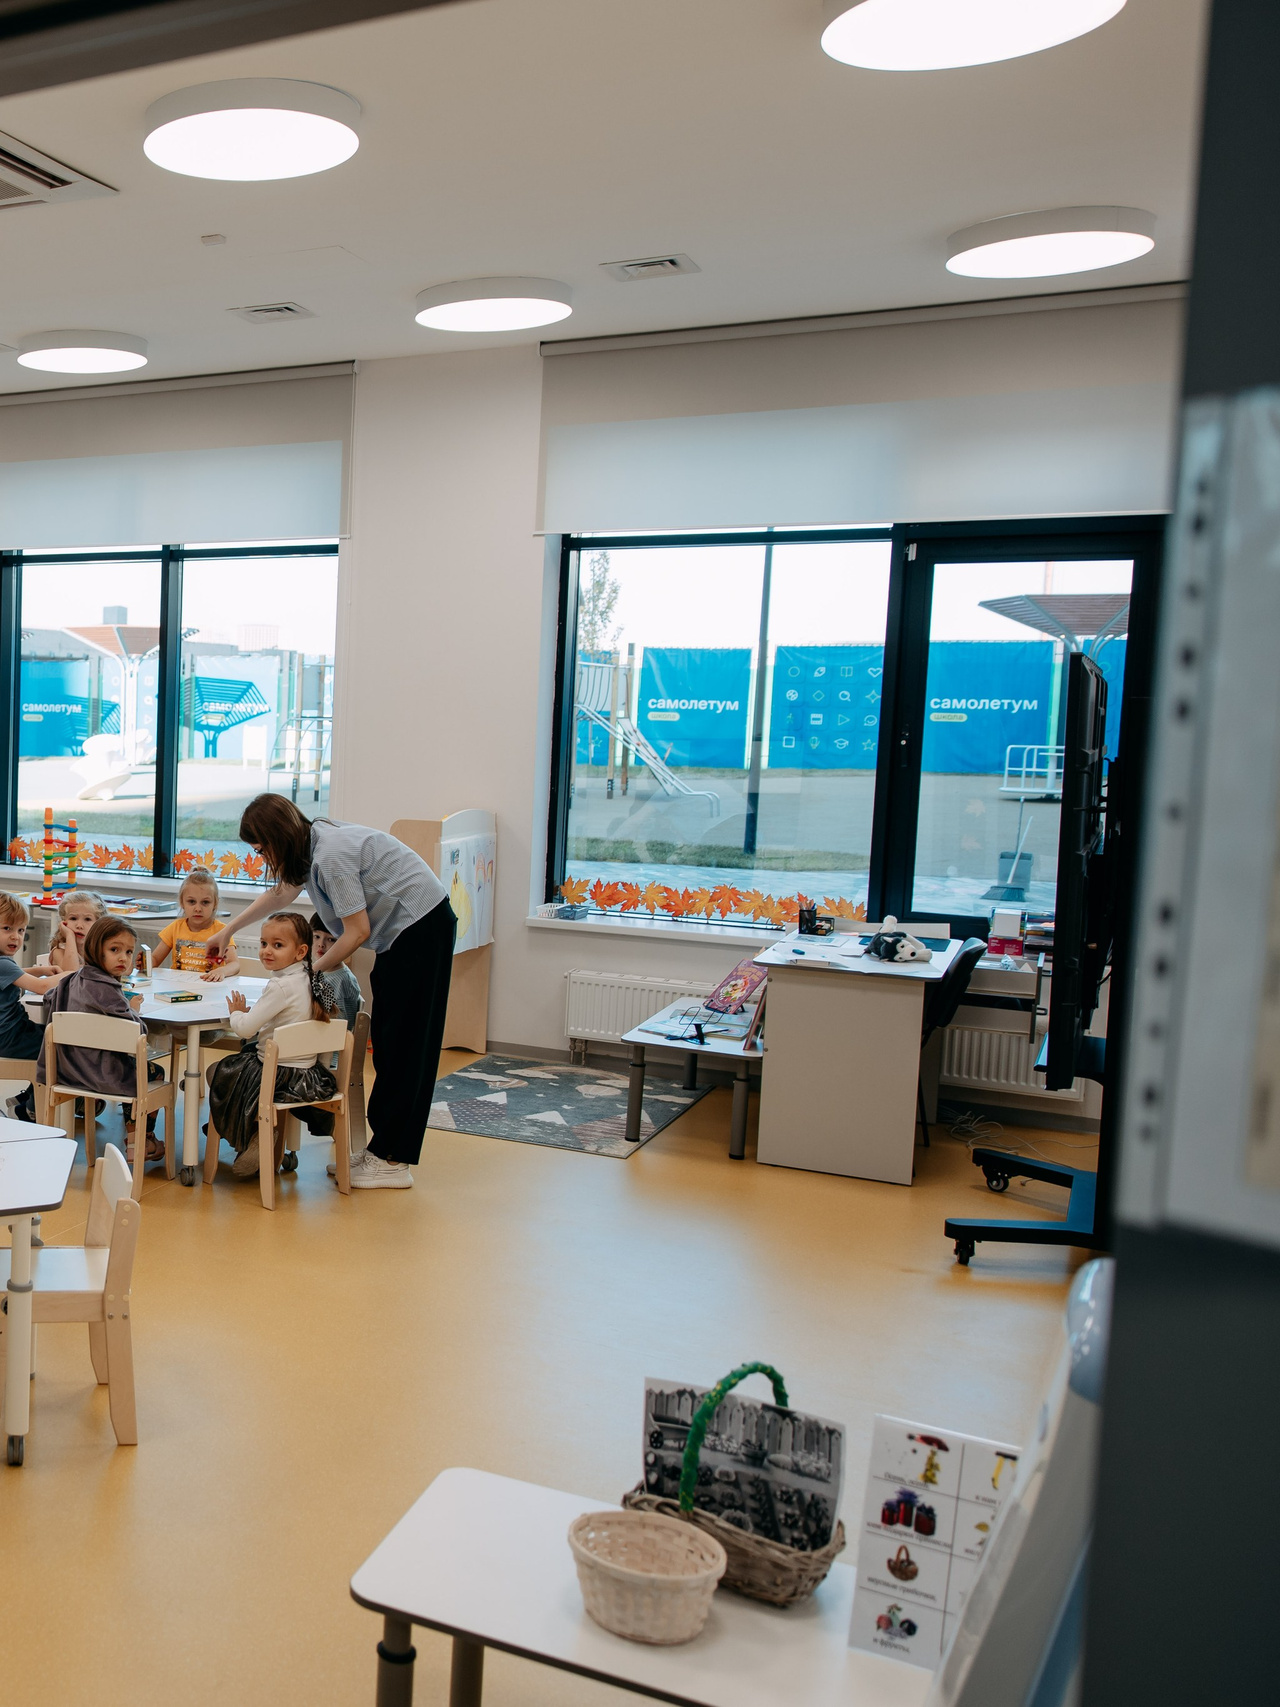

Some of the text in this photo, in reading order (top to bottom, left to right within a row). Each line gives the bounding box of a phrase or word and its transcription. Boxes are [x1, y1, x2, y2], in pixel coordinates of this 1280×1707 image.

[22, 703, 82, 715] самолетум
[648, 698, 739, 713] самолетум
[929, 698, 1038, 713] самолетум
